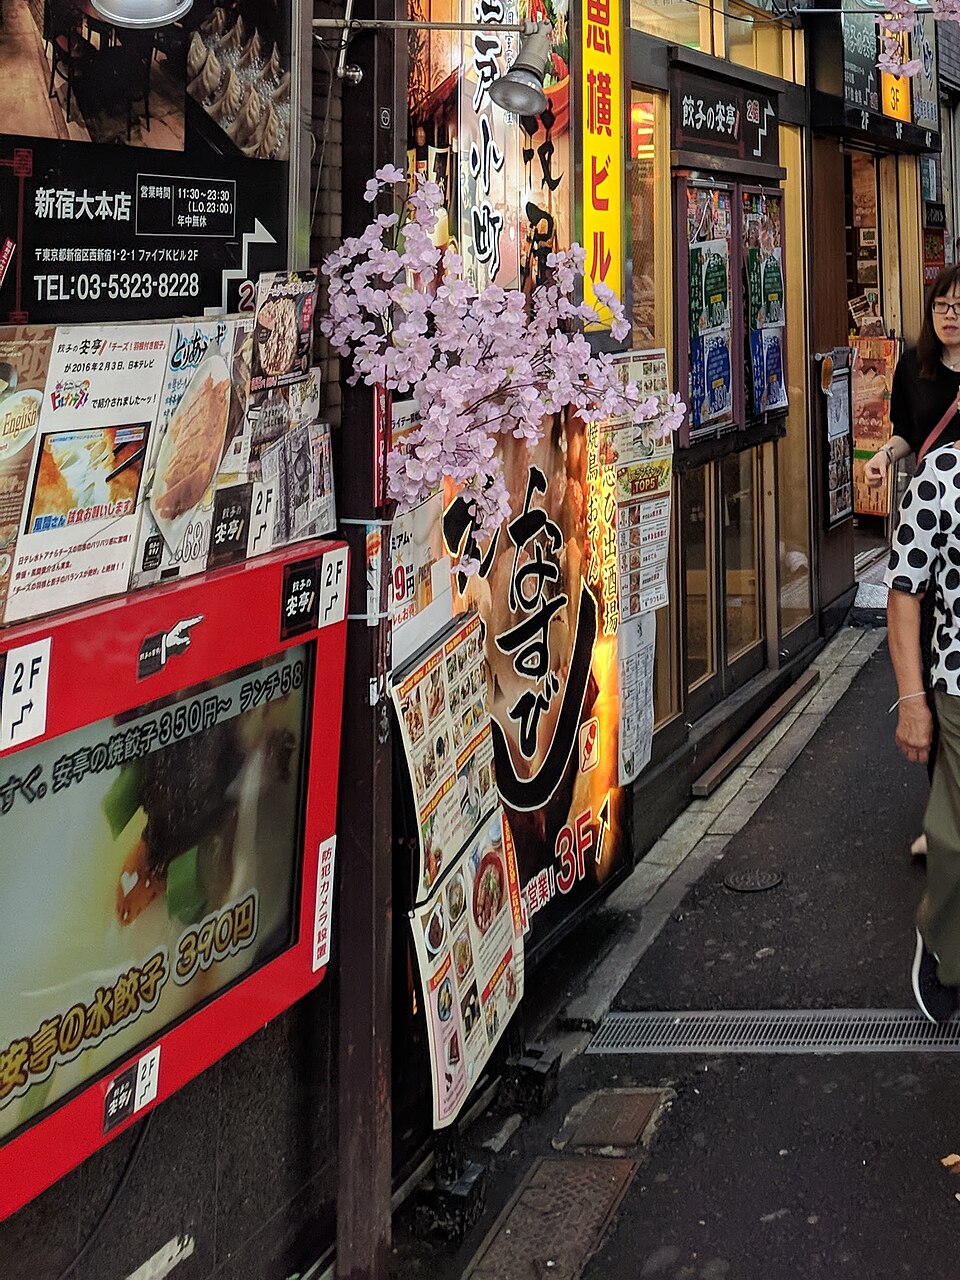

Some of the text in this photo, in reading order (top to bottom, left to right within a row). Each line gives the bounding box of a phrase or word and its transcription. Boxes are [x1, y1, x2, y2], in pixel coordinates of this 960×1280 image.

[890, 86, 900, 112] 3F
[682, 95, 736, 135] 餃子の安亭
[34, 186, 132, 221] 新宿大本店
[140, 185, 171, 200] 営業時間
[177, 215, 207, 228] 年中無休
[33, 273, 199, 301] TEL:03-5323-8228
[2, 407, 39, 436] English
[256, 488, 273, 516] 2F
[326, 559, 343, 588] 2F
[285, 591, 310, 618] 安亭
[12, 656, 42, 695] 2F
[555, 810, 593, 894] 3F
[316, 846, 334, 958] 防犯カメラ設置
[175, 894, 255, 975] 390円
[140, 1057, 156, 1081] 2F
